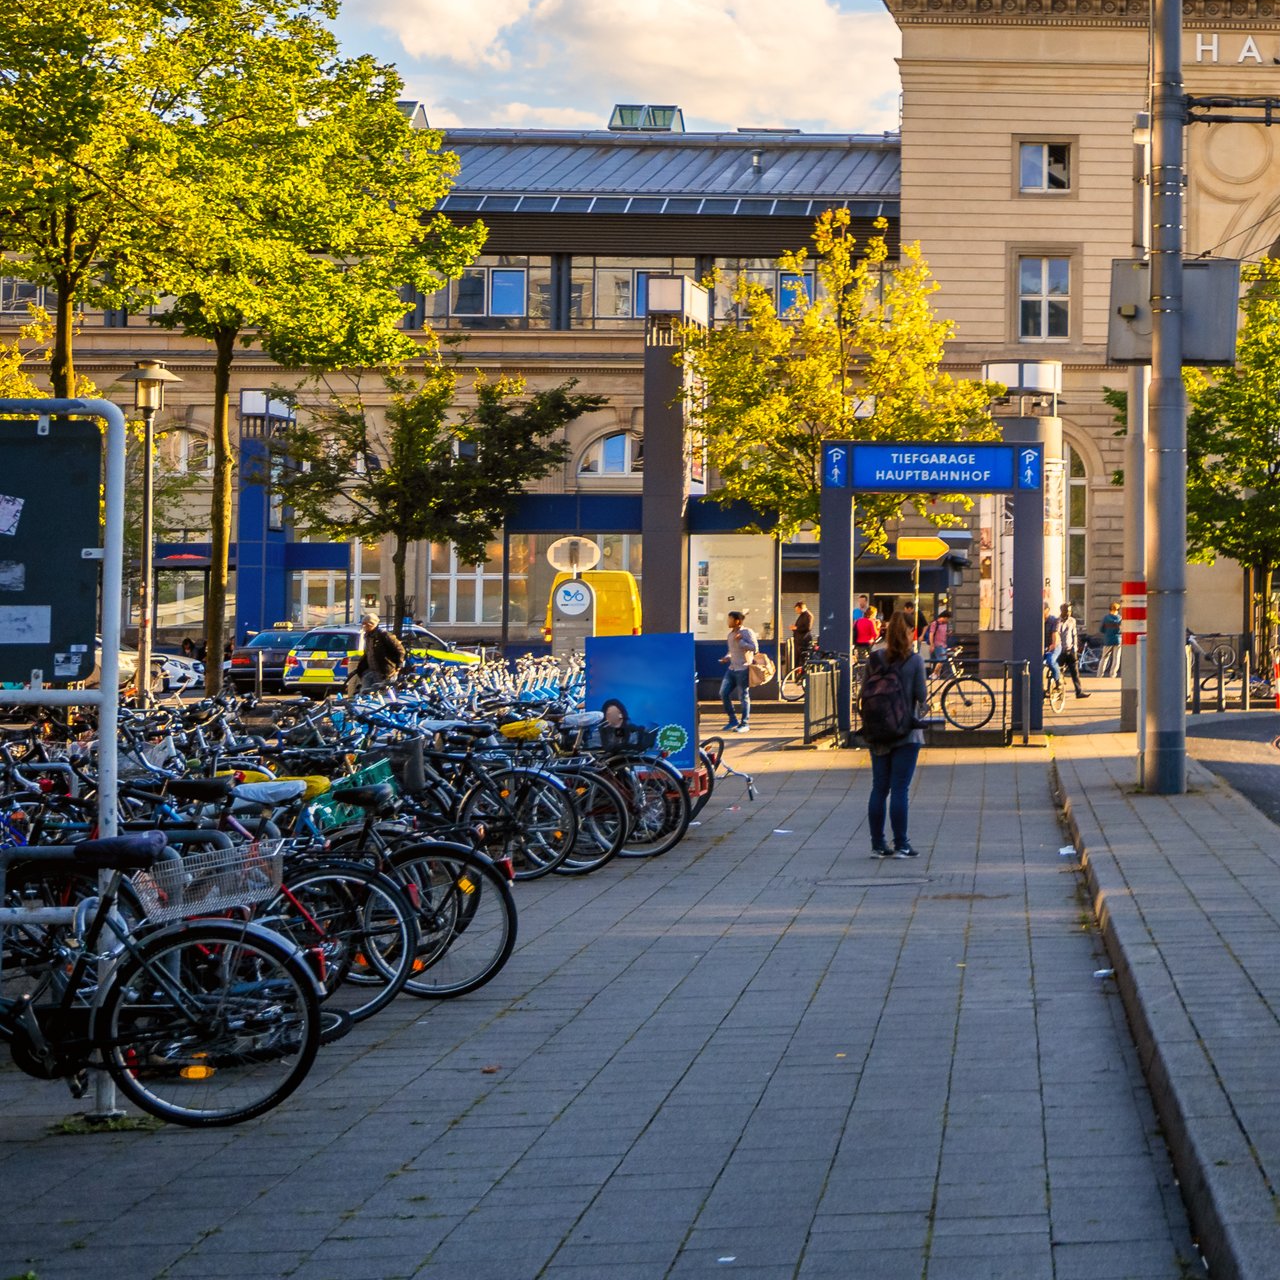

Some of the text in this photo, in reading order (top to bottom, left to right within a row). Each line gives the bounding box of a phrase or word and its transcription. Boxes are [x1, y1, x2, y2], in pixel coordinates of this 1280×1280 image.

[833, 452, 842, 463] P
[891, 453, 976, 465] TIEFGARAGE
[1025, 455, 1035, 465] P
[876, 470, 991, 482] HAUPTBAHNHOF
